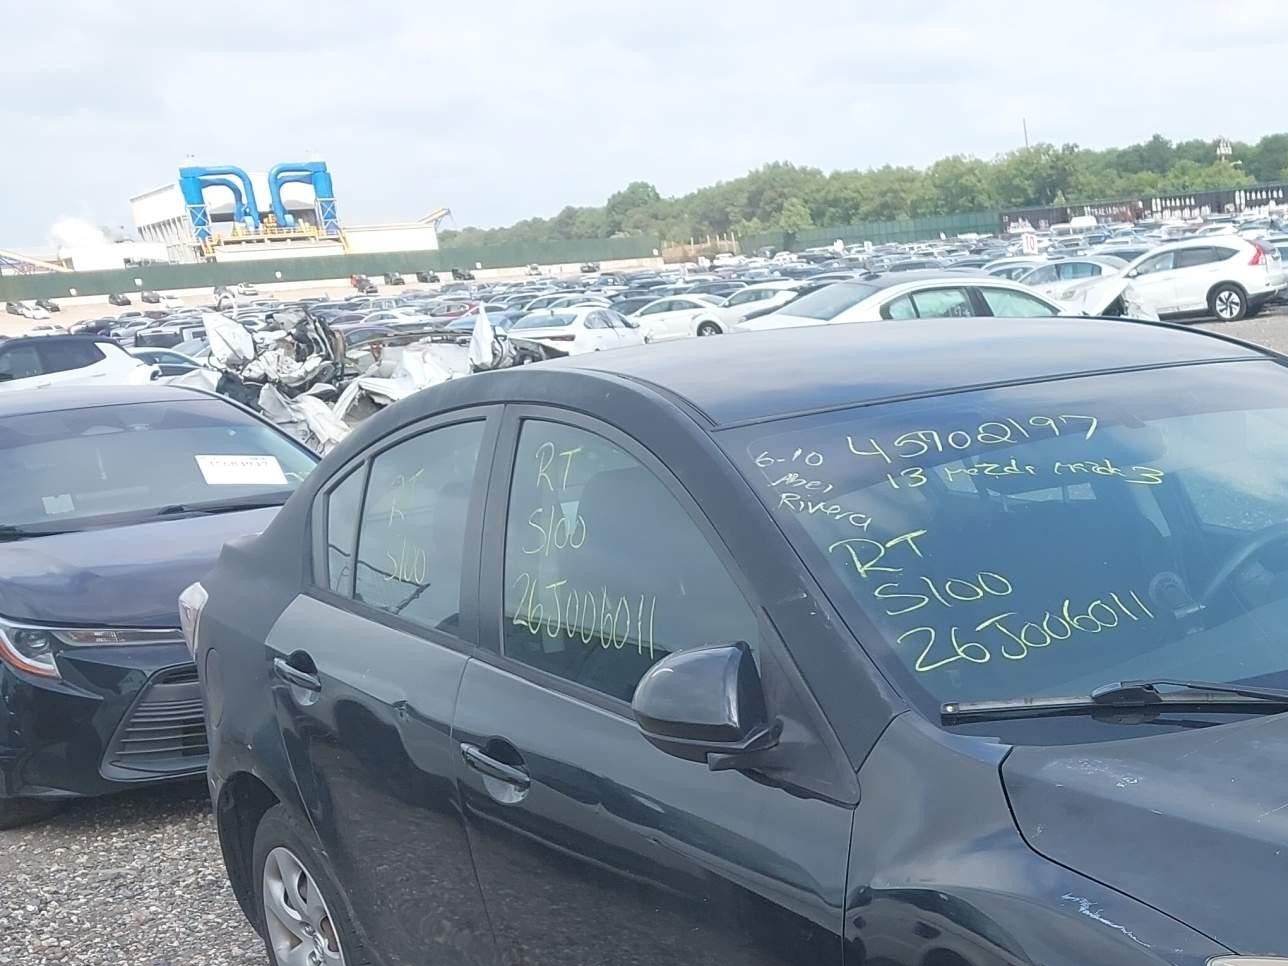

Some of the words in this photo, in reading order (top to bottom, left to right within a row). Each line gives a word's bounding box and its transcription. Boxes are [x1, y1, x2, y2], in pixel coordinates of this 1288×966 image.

[847, 416, 1098, 464] 45702197
[535, 441, 583, 492] RT
[887, 467, 927, 489] 13
[829, 529, 928, 578] RT
[512, 572, 656, 660] 26J006011
[896, 590, 1155, 673] 26J006011
